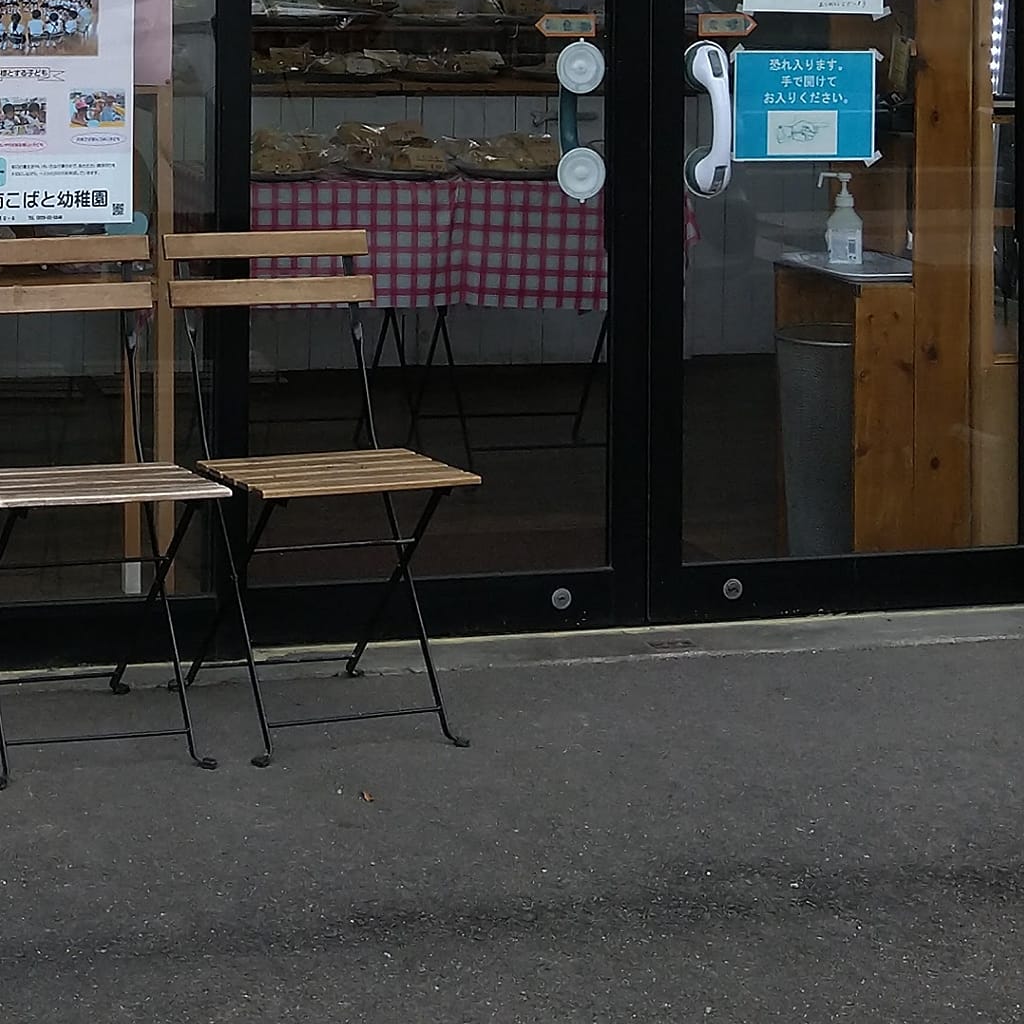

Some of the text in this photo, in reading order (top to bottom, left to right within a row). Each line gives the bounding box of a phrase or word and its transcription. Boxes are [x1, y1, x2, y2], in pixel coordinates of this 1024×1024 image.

[769, 58, 844, 72] 恐れ入ります。
[781, 75, 837, 87] 手で開けて
[763, 92, 850, 104] お入りください。
